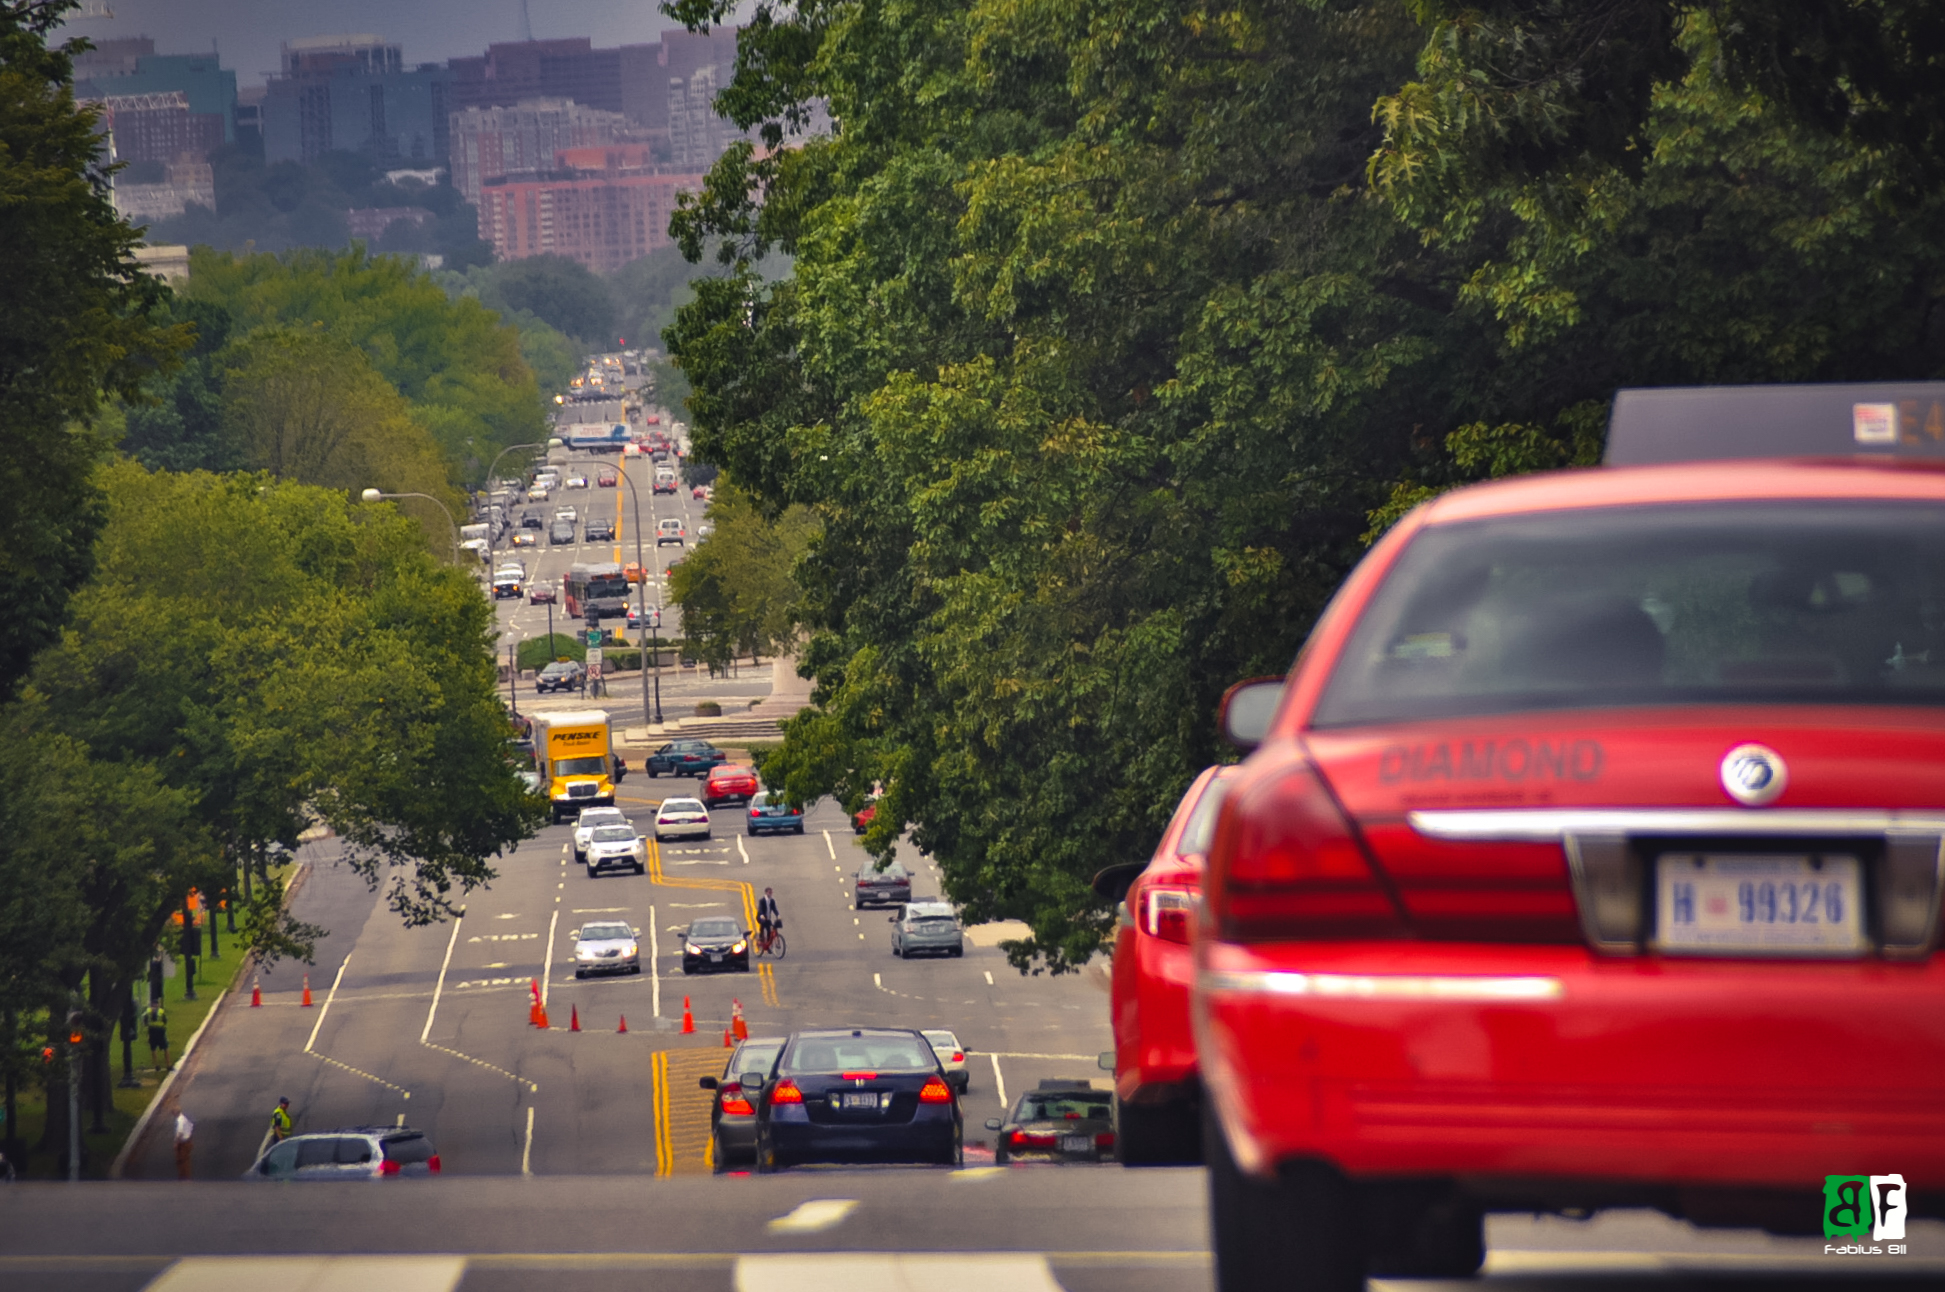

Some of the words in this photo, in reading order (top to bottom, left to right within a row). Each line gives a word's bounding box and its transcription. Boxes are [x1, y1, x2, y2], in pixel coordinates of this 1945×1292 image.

[552, 731, 602, 741] PENSKE
[1380, 739, 1604, 785] DIAMOND
[1738, 882, 1843, 924] 99326
